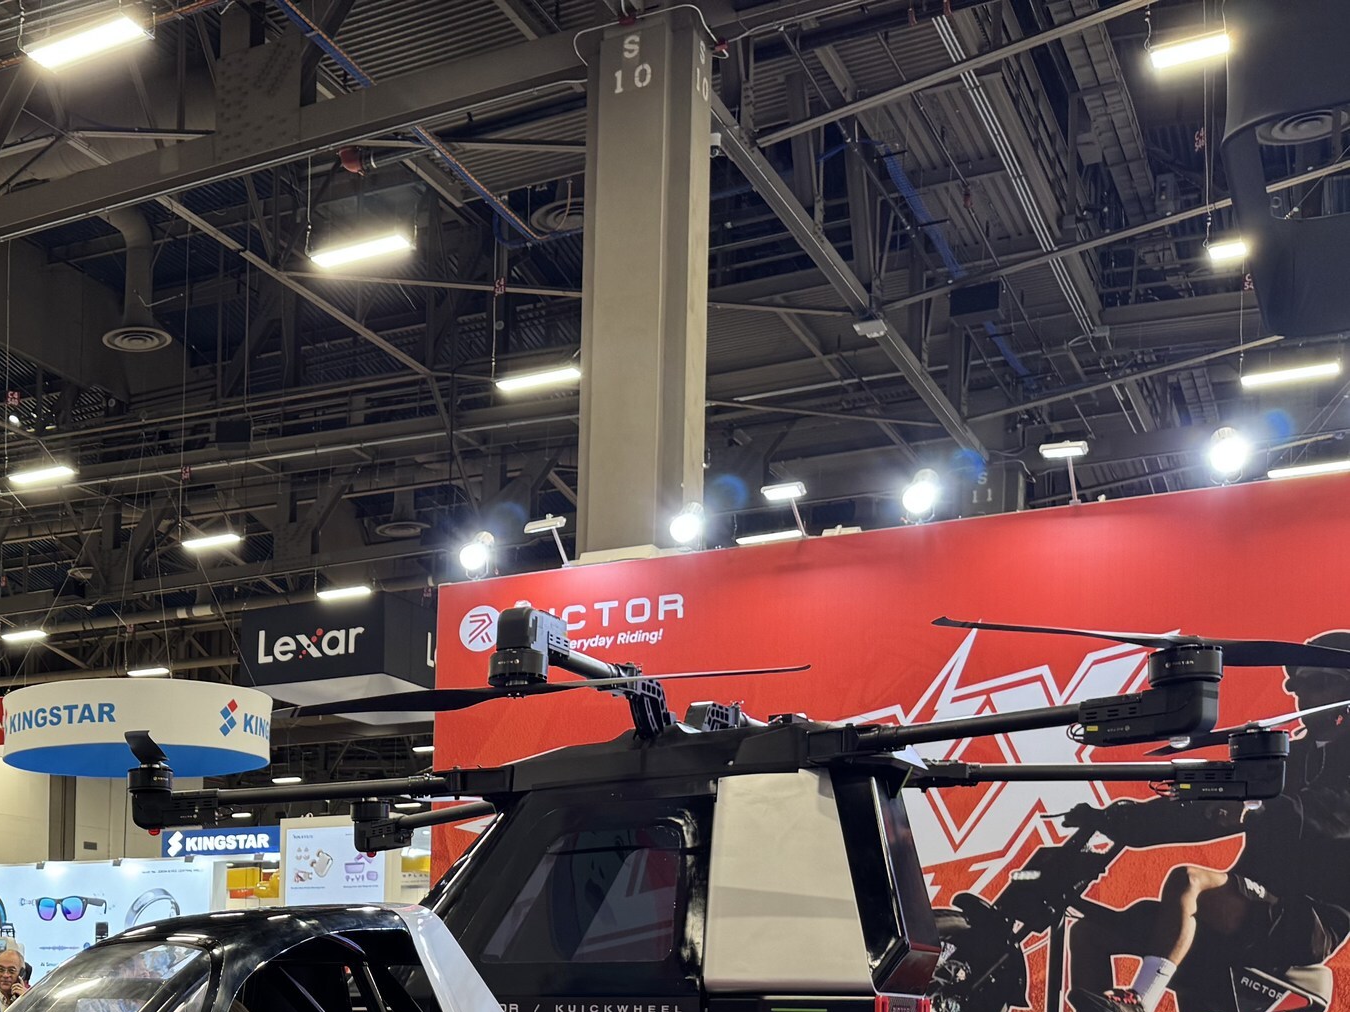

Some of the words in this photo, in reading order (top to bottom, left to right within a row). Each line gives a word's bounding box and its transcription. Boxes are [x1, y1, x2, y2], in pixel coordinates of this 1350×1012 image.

[623, 35, 640, 58] S
[614, 63, 652, 94] 10
[258, 626, 365, 664] Lexar
[617, 628, 663, 645] Riding!
[9, 703, 116, 734] KINGSTAR
[185, 833, 270, 852] KINGSTAR
